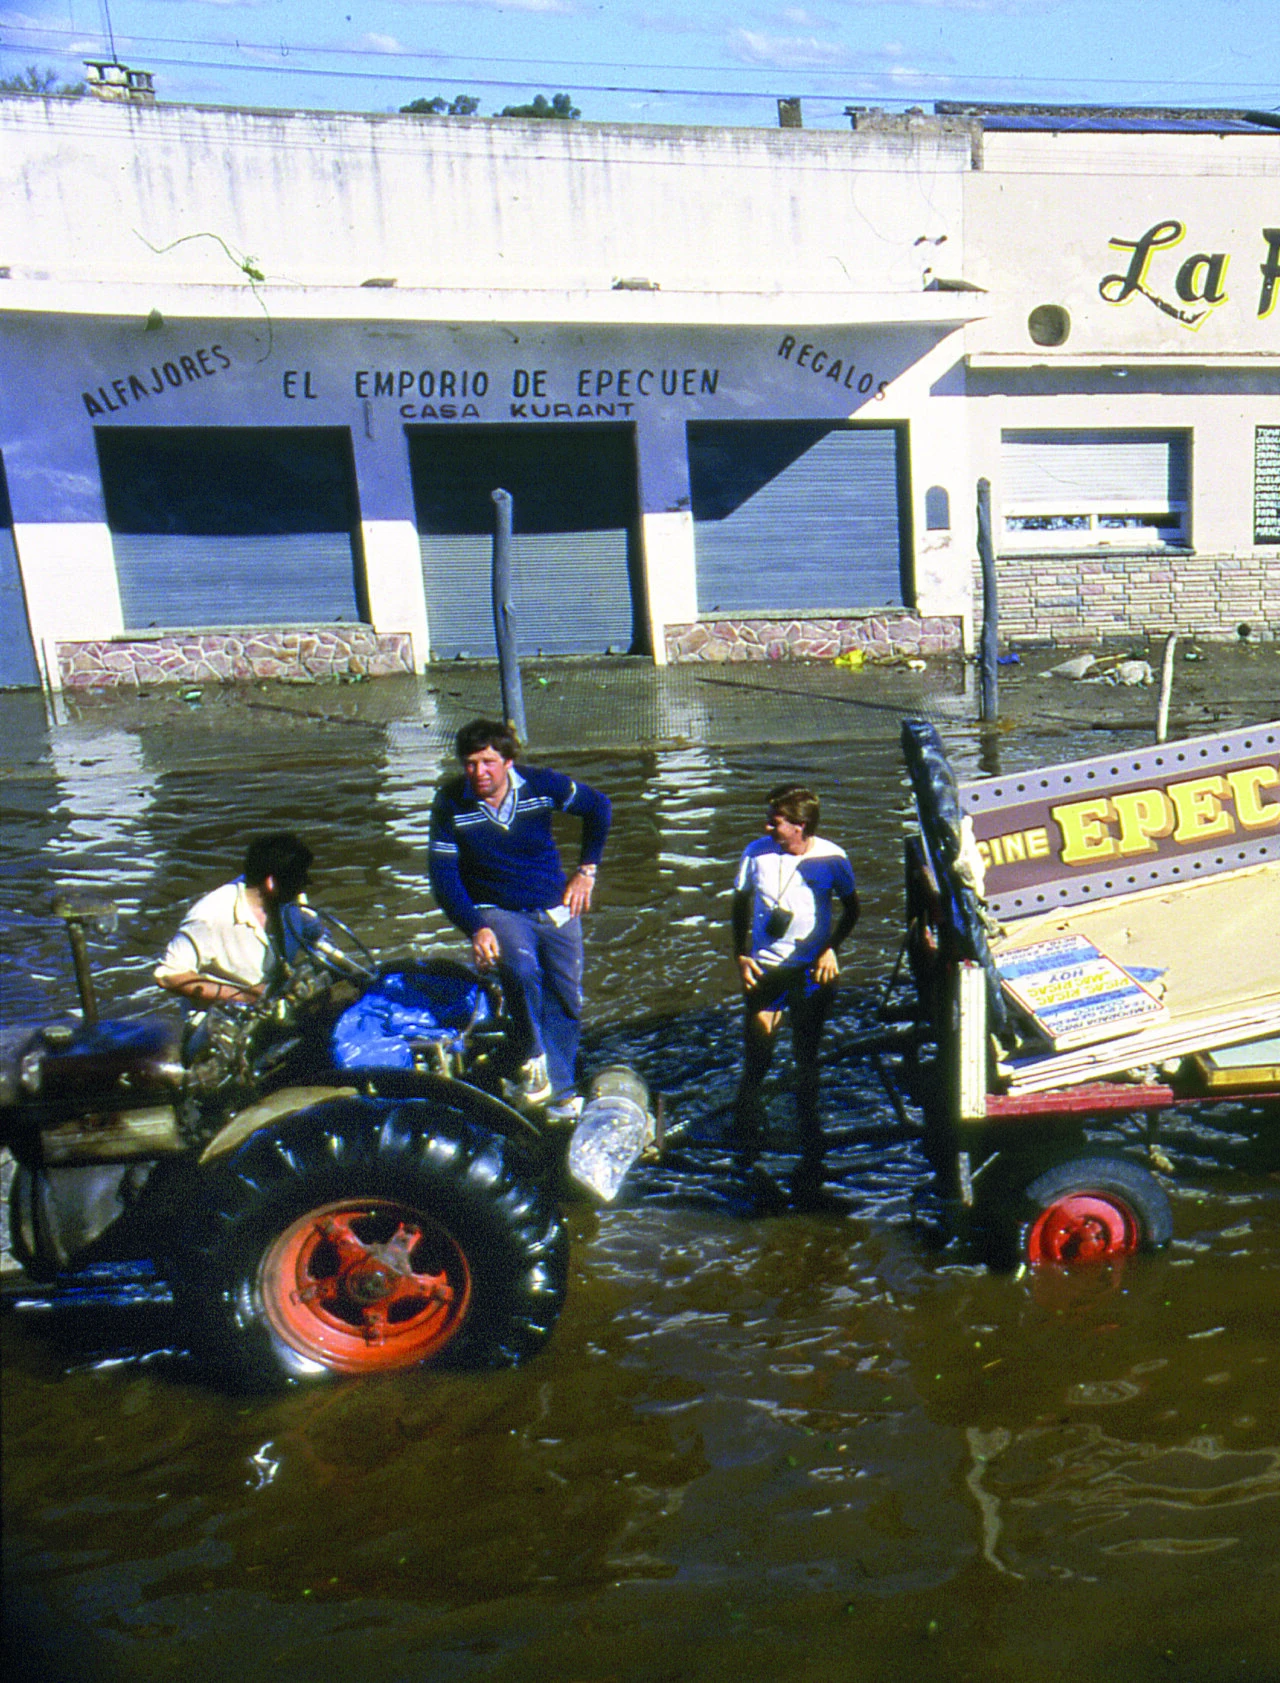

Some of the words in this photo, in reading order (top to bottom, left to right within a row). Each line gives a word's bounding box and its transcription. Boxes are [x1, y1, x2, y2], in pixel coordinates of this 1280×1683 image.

[1098, 220, 1231, 331] La
[82, 344, 231, 417] ALFAJORES
[283, 370, 317, 399] EL
[355, 370, 489, 398] EMPORIO
[513, 369, 548, 398] DE
[577, 368, 720, 397] EPECUEN
[400, 403, 480, 418] CASA
[510, 402, 635, 418] KURANT
[975, 824, 1050, 869] CINE
[1049, 968, 1084, 983] HOY
